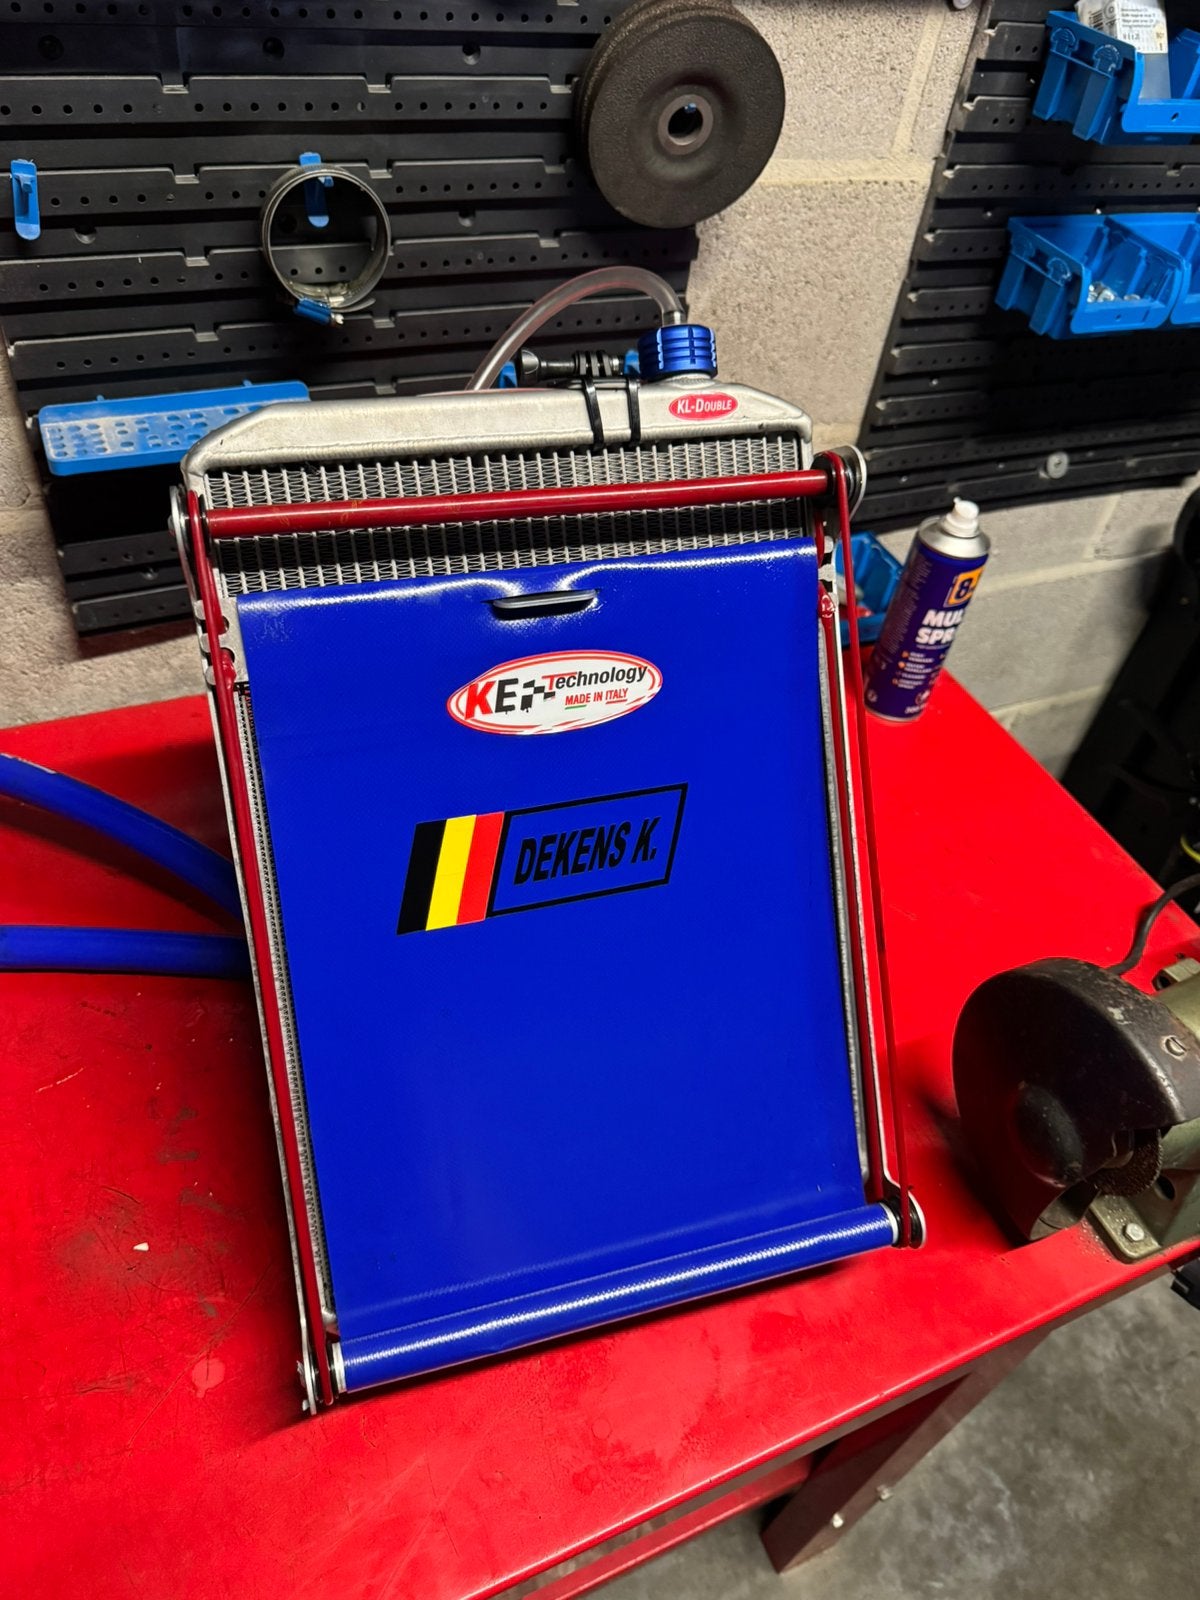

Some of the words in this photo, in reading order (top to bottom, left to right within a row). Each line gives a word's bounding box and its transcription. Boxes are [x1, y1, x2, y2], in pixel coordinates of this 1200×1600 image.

[542, 665, 648, 691] Technology
[565, 693, 591, 706] MADE
[593, 691, 603, 702] IN
[605, 688, 628, 702] ITALY
[514, 822, 631, 885] DEKENS
[631, 817, 662, 864] K.
